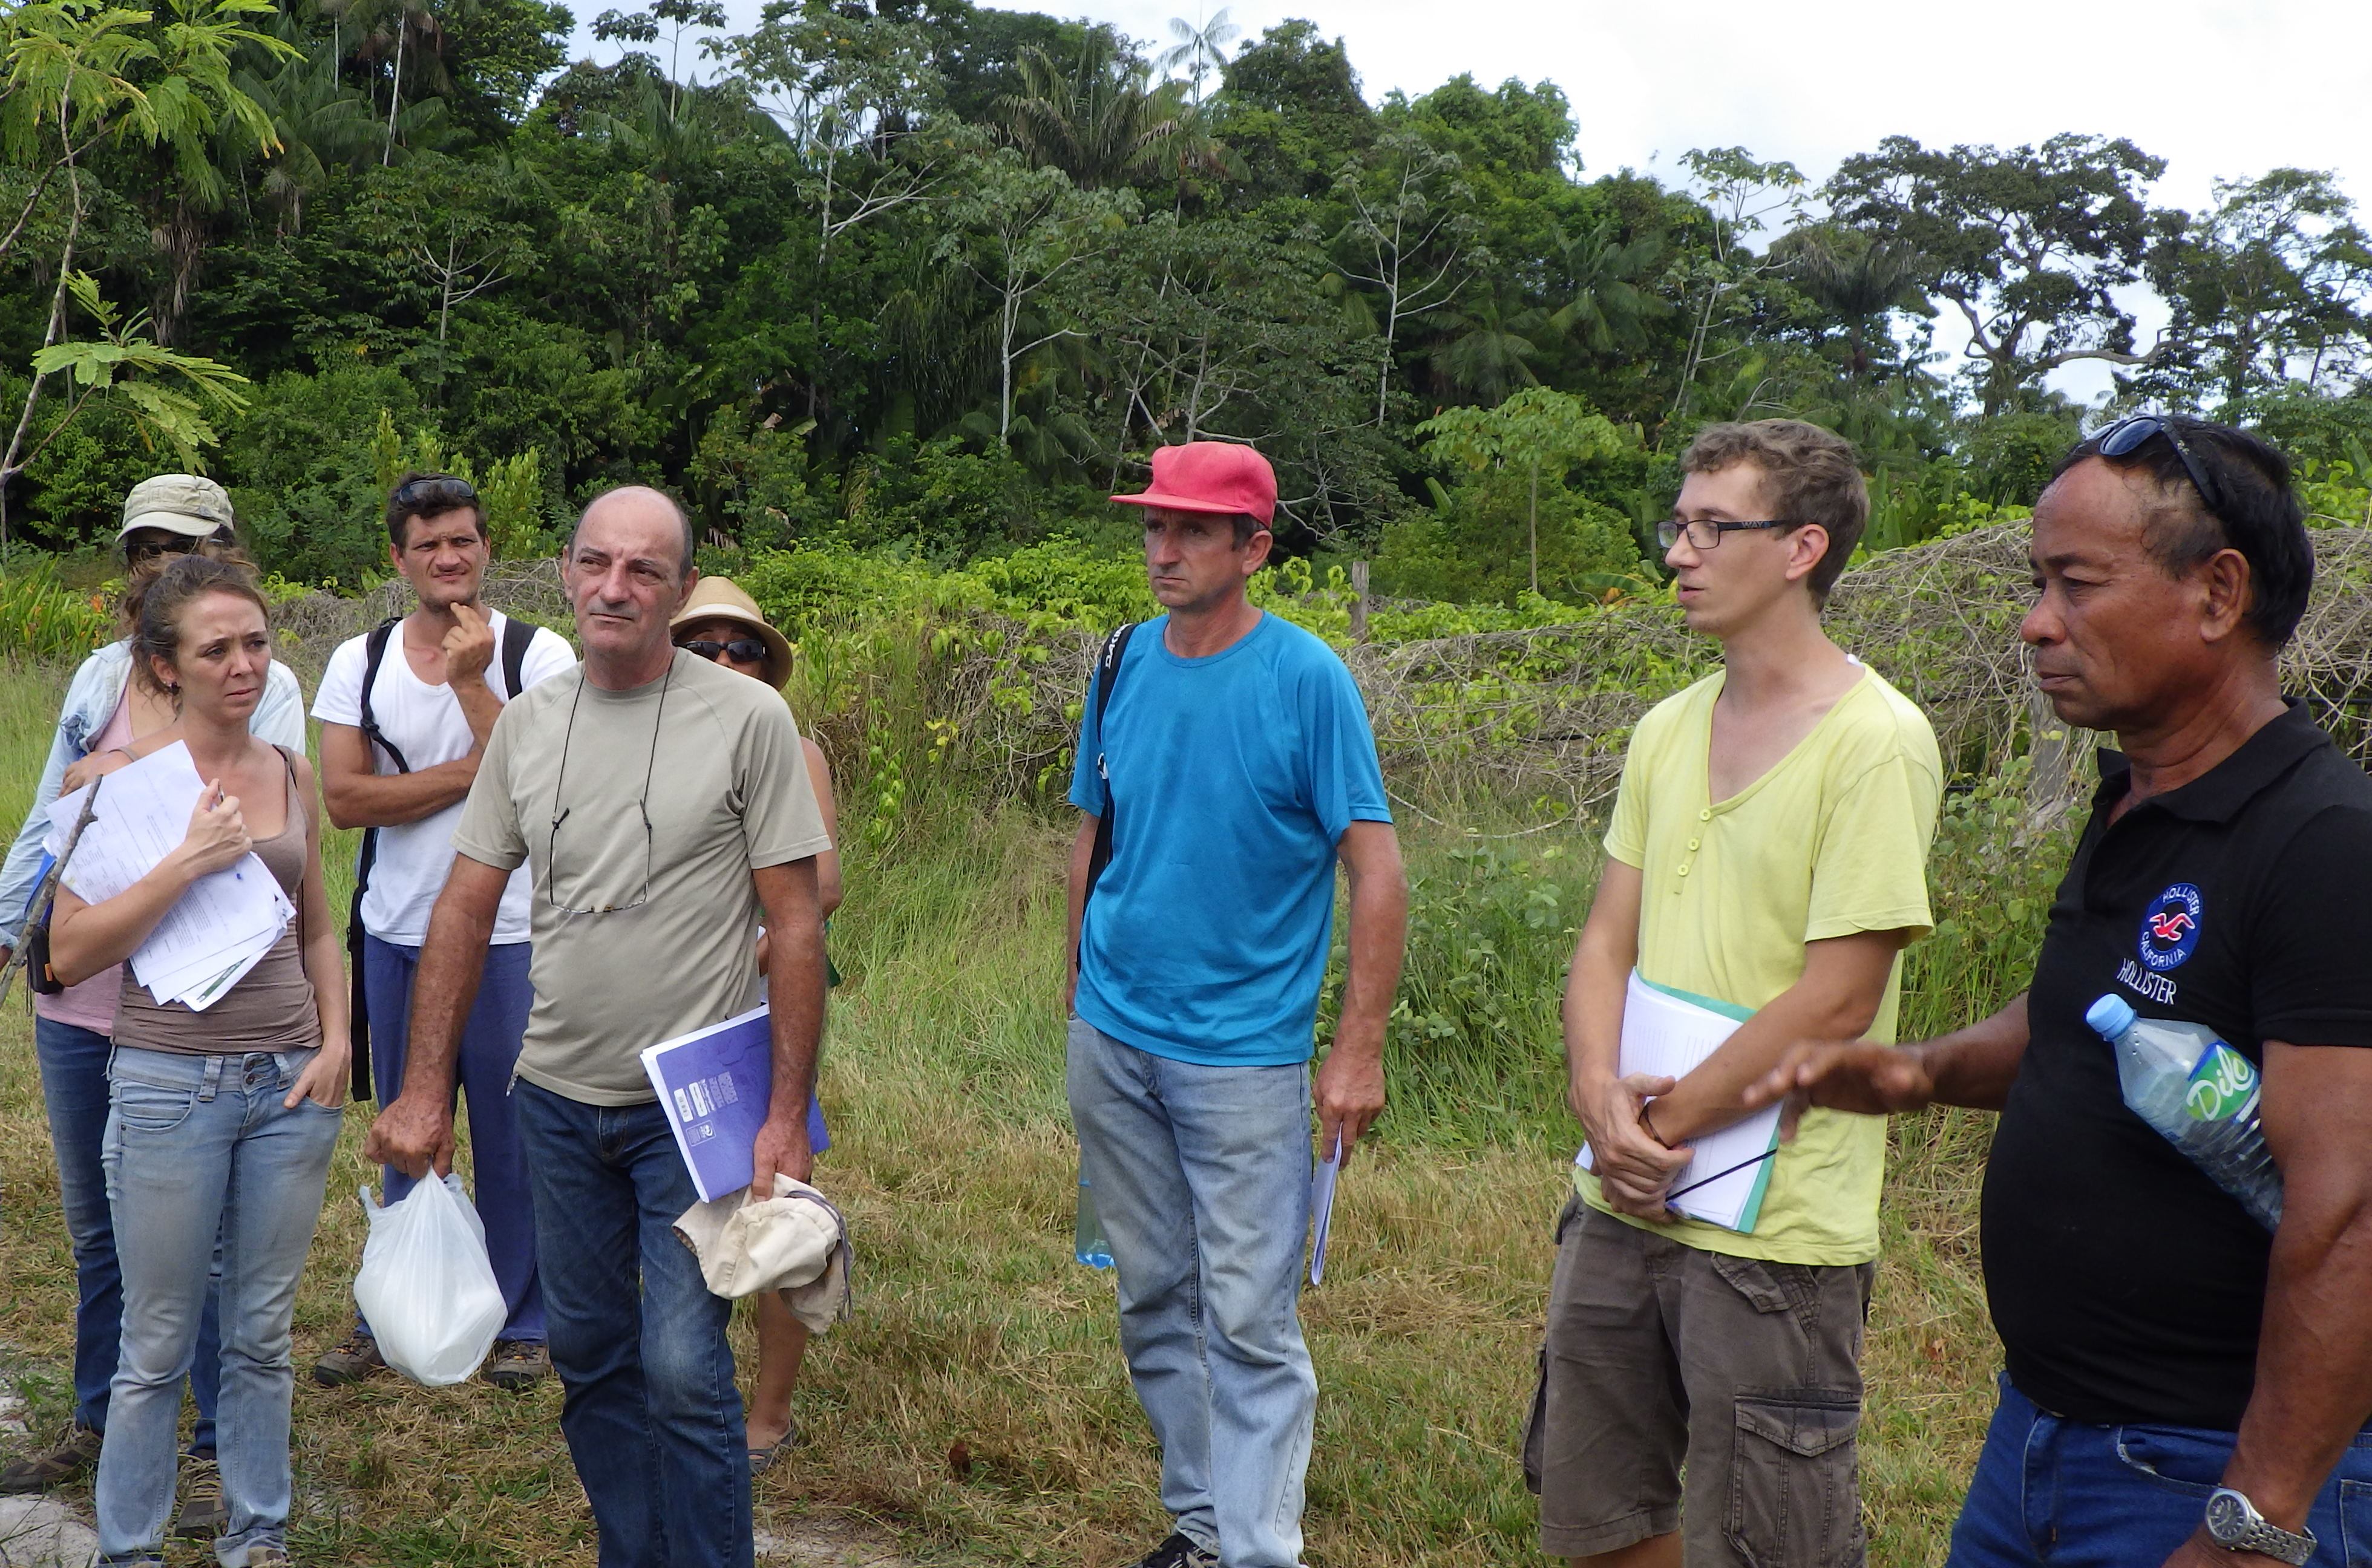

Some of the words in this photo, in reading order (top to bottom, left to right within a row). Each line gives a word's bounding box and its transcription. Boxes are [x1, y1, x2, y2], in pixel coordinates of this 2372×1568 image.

[2163, 886, 2200, 916] HOLLISTER
[2141, 931, 2187, 967] CALIFORNIA
[2117, 958, 2177, 1005] HOLLISTER
